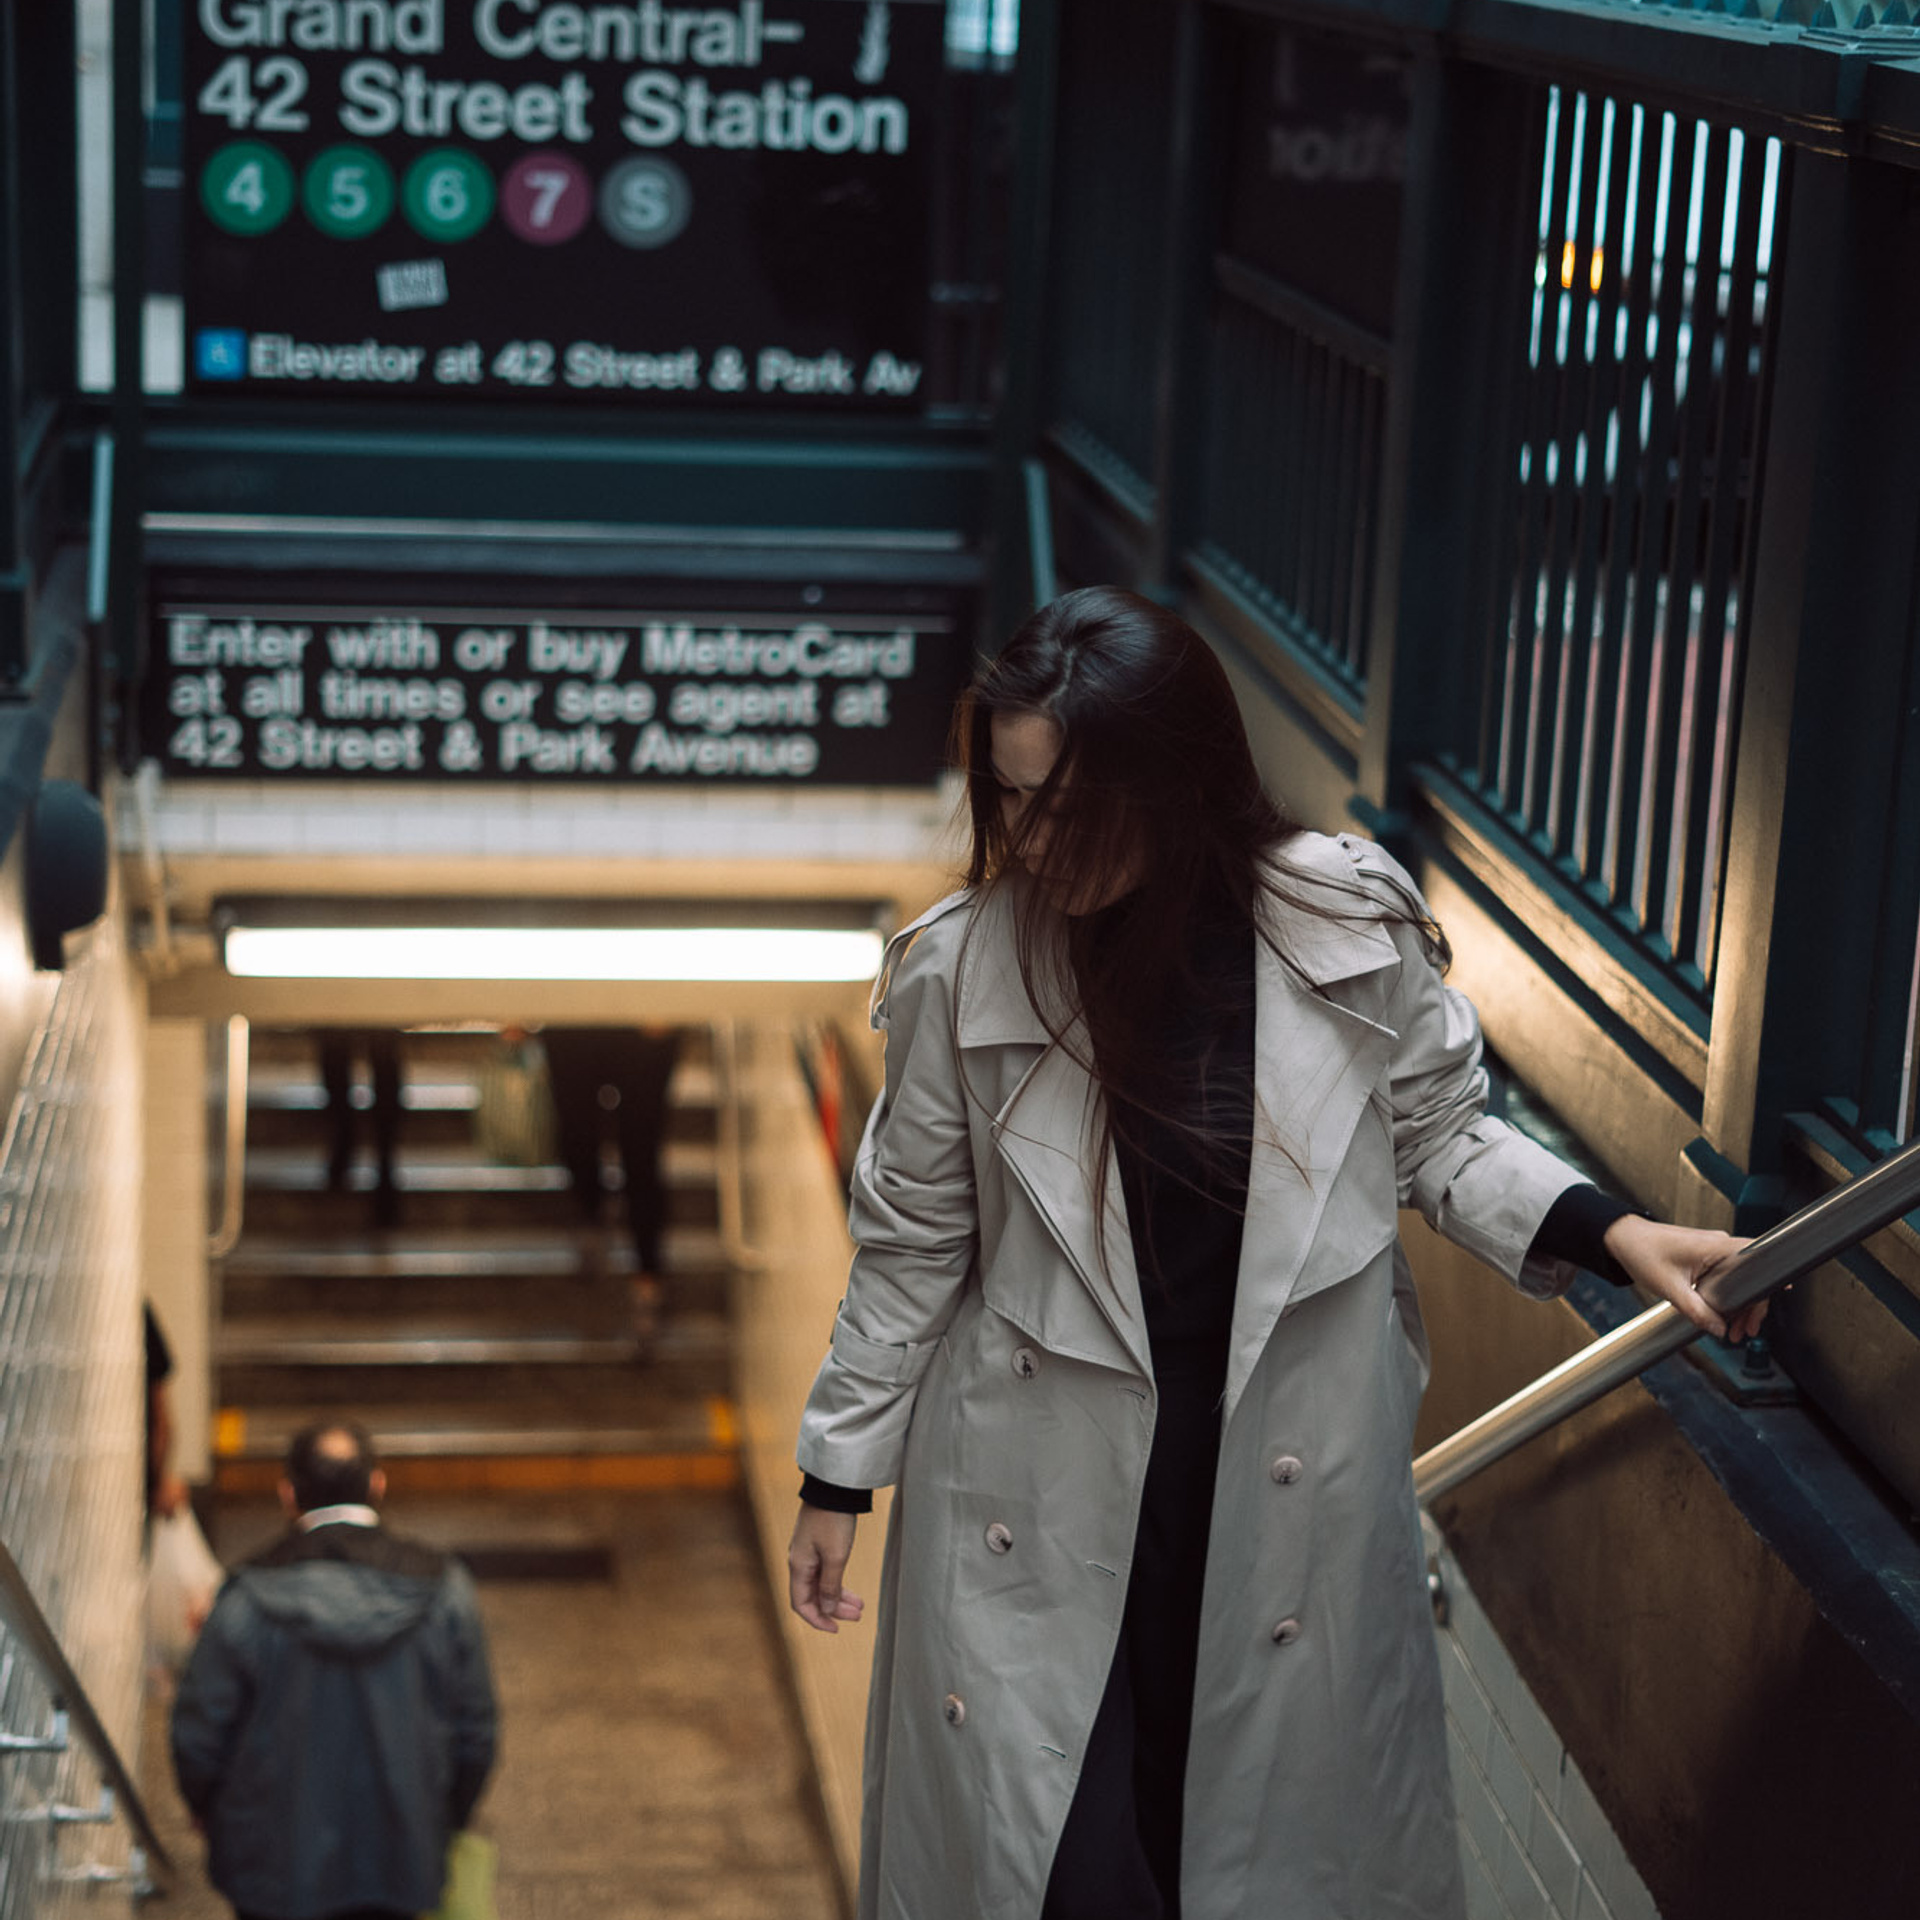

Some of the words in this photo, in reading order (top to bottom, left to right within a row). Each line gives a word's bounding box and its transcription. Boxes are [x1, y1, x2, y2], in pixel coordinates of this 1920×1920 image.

[199, 0, 444, 52] Grand
[198, 57, 309, 132] 42
[338, 60, 592, 142] Street
[621, 71, 909, 154] Station
[225, 162, 265, 215] 4
[328, 166, 369, 220] 5
[425, 168, 468, 222] 6
[526, 172, 570, 228] 7
[621, 174, 668, 230] S
[249, 334, 424, 382] Elevator
[434, 341, 482, 383] at
[492, 341, 555, 387] 42
[564, 343, 699, 391] Street
[709, 350, 747, 391] &
[757, 350, 853, 394] Park
[864, 354, 921, 395] Av
[168, 613, 312, 668] Enter
[327, 615, 441, 669] with
[453, 627, 516, 671] or
[527, 619, 629, 682] buy
[641, 620, 914, 678] MetroCard
[168, 668, 226, 717] at
[242, 668, 304, 718] all
[320, 667, 467, 721] times
[480, 679, 543, 722] or
[554, 681, 656, 724] see
[669, 678, 821, 735] agent
[831, 679, 890, 727] at
[169, 714, 244, 769] 42
[257, 716, 424, 770] Street
[439, 718, 482, 772] &
[497, 721, 618, 774] Park
[630, 720, 820, 777] Avenue
